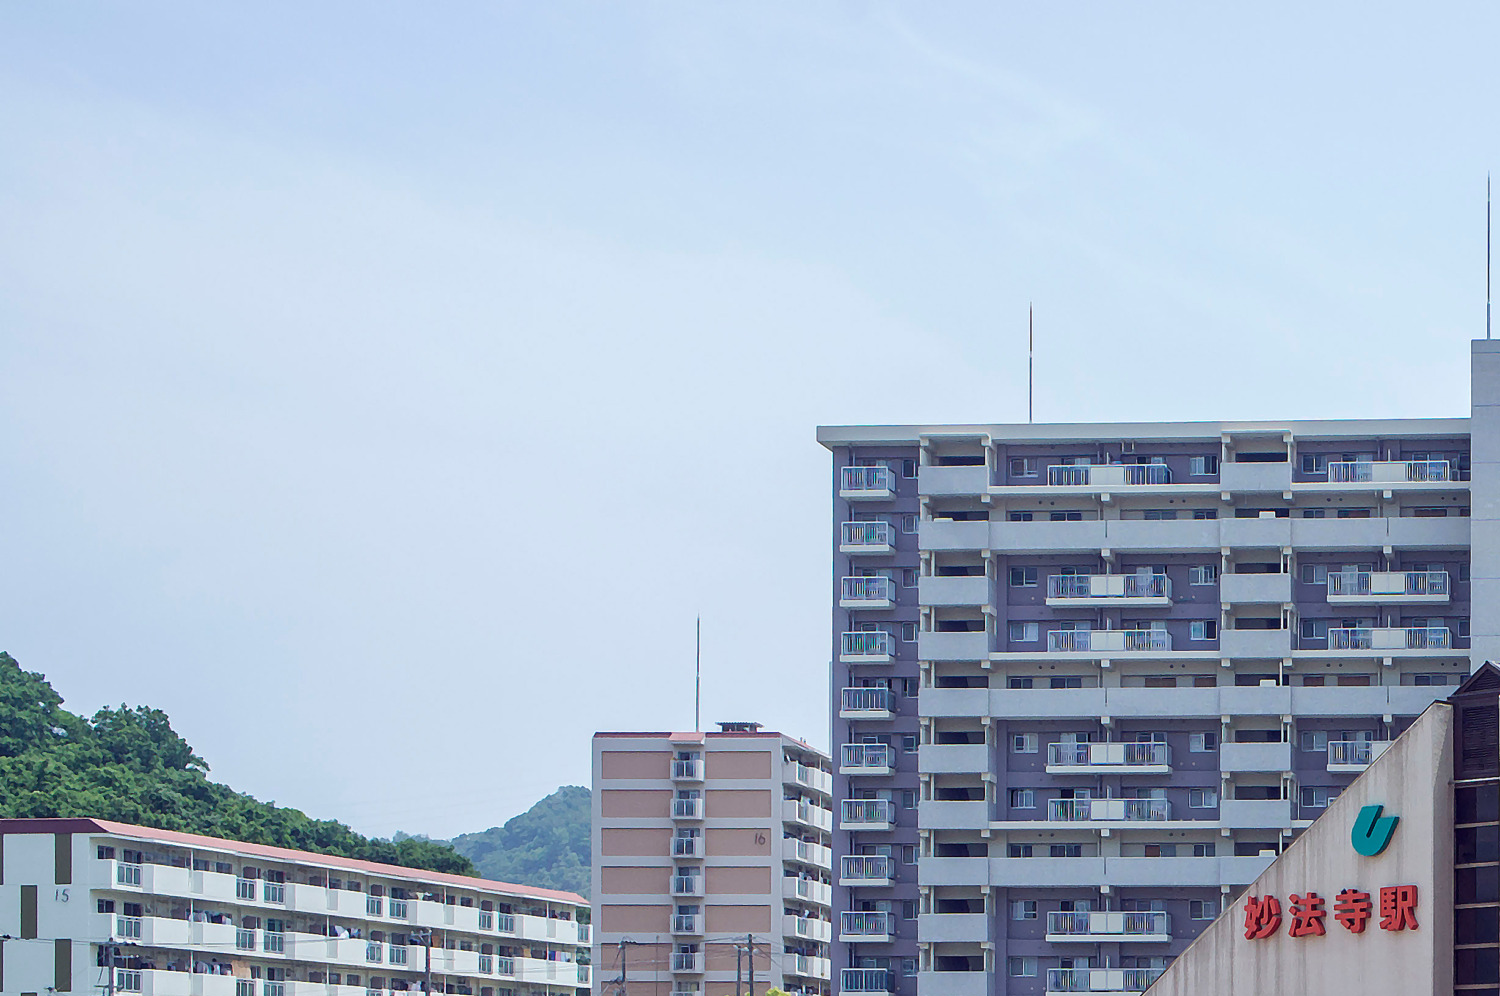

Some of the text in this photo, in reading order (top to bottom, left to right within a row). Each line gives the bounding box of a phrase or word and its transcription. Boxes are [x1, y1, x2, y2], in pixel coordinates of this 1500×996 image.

[754, 832, 766, 846] 16
[54, 888, 70, 903] 15
[1244, 884, 1419, 940] 妙法寺駅
